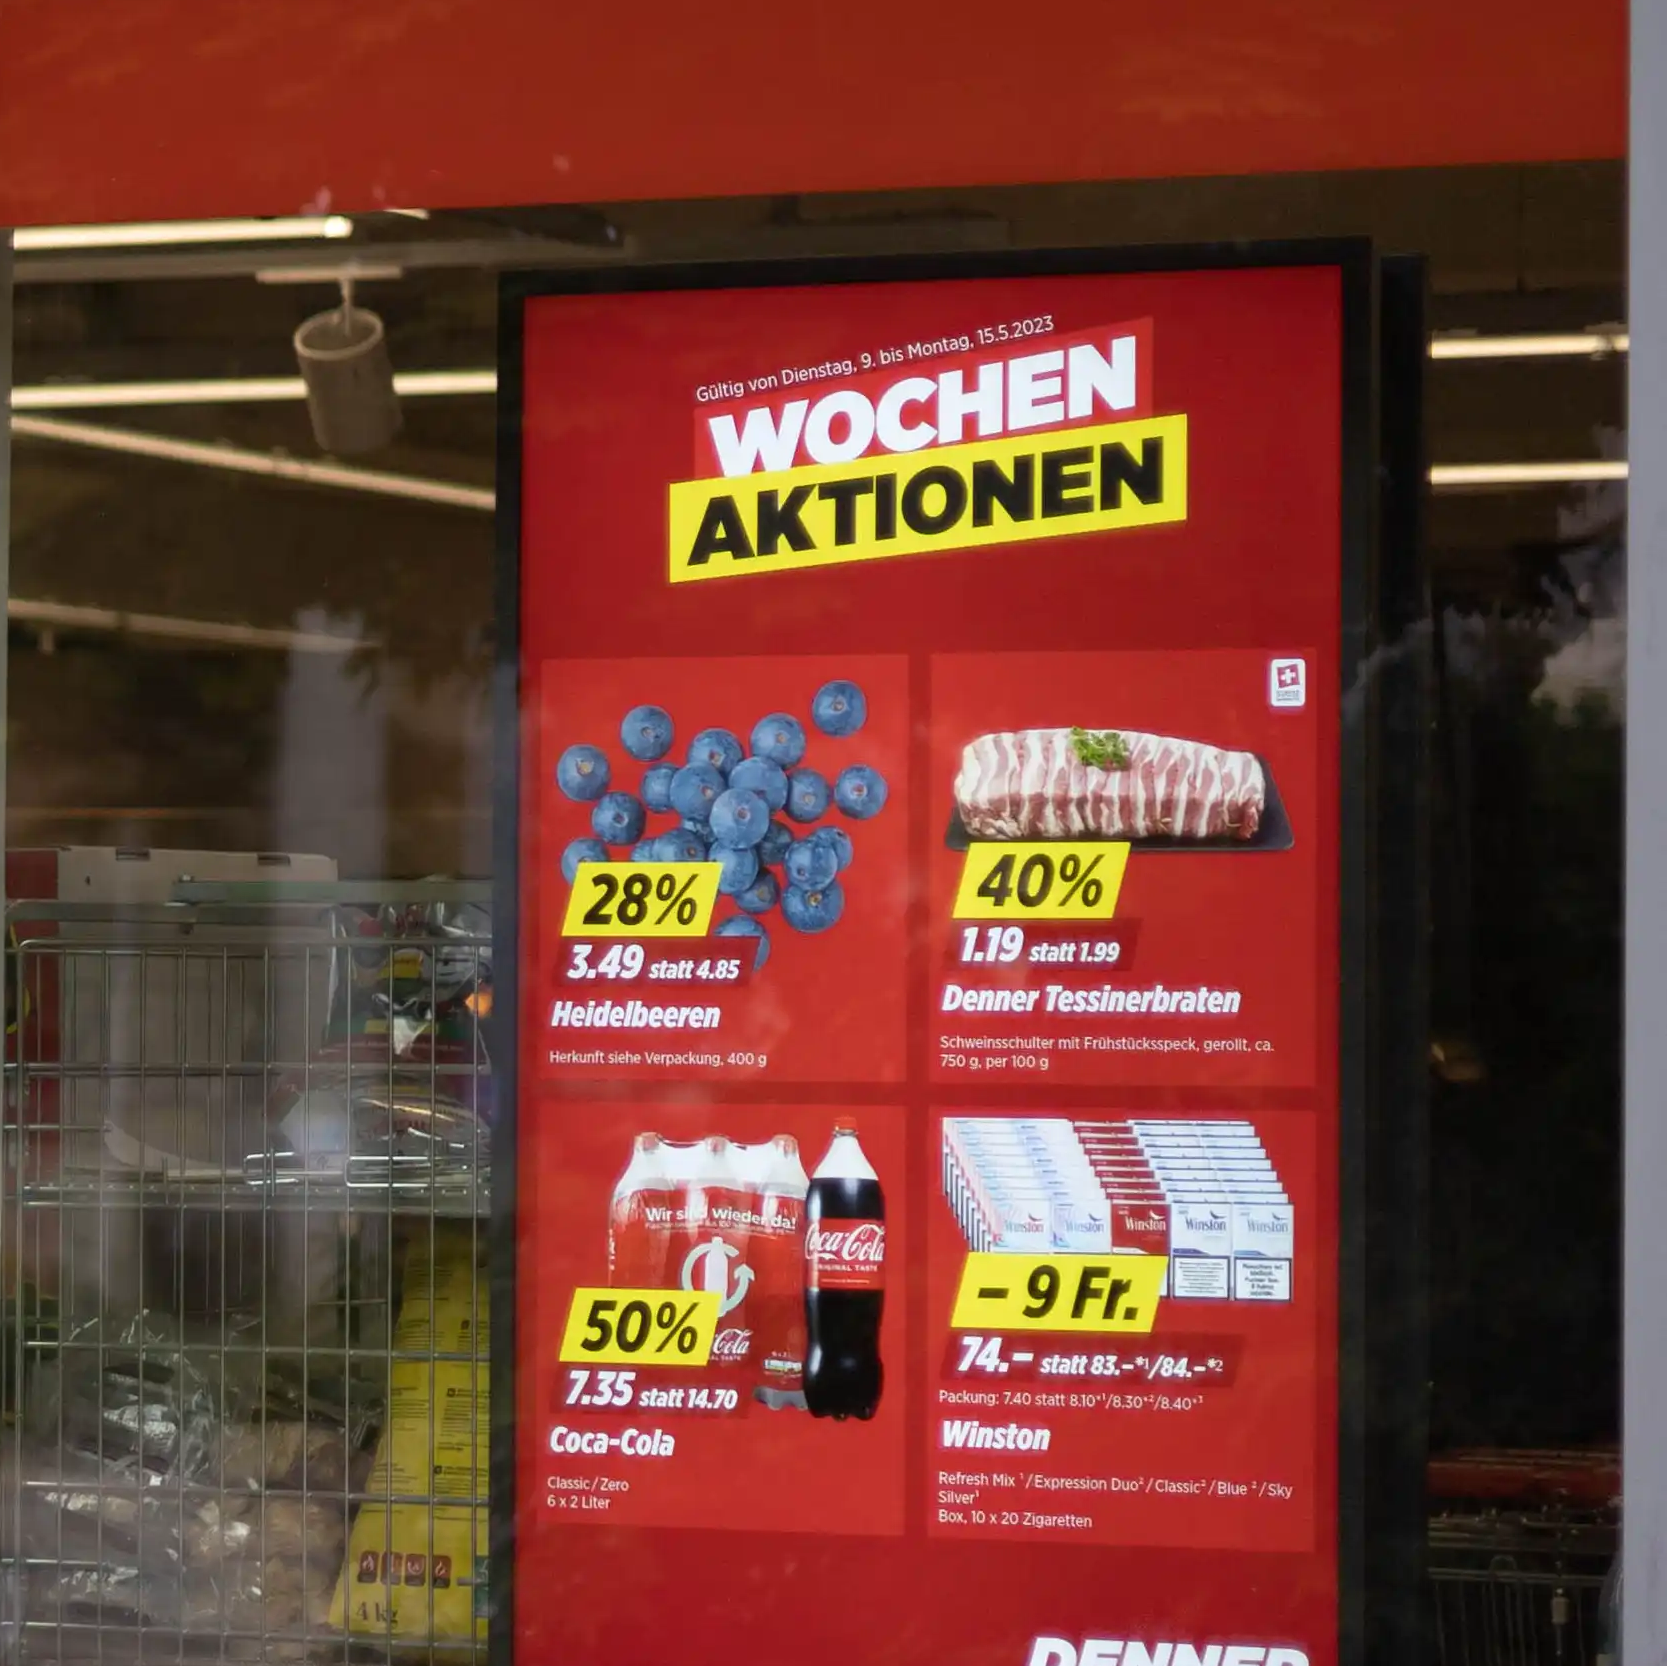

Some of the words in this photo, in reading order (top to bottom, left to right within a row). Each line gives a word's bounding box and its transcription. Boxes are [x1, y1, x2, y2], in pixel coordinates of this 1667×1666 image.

[696, 379, 744, 402] Gültig
[748, 374, 778, 391] von
[782, 357, 858, 385] Dienstag,
[861, 352, 876, 369] 9.
[880, 345, 904, 365] bis
[908, 334, 974, 359] Montag,
[977, 314, 1054, 344] 15.5.2023
[709, 334, 1136, 479] WOCHEN
[686, 435, 1163, 566] AKTIONEN
[977, 853, 1106, 908] 40%
[582, 873, 699, 926] 28%
[961, 926, 1024, 963] 1.19
[1029, 943, 1076, 962] statt
[1080, 942, 1121, 963] 1.99
[567, 944, 645, 980] 3.49
[649, 960, 694, 980] statt
[696, 959, 741, 980] 4.85
[941, 984, 1040, 1012] Denner
[1045, 984, 1242, 1014] Tessinerbraten
[551, 1000, 721, 1028] Heidelbeeren
[940, 1036, 1054, 1051] Schweinsschulter
[1058, 1036, 1081, 1051] mit
[1084, 1036, 1200, 1052] Frühstücksspeck,
[1204, 1037, 1252, 1053] gerollt,
[1255, 1041, 1275, 1052] ca.
[549, 1050, 605, 1065] Herkunft
[608, 1051, 642, 1065] siehe
[645, 1052, 724, 1067] Verpackung,
[727, 1053, 755, 1066] 400
[758, 1054, 767, 1068] g
[940, 1055, 966, 1068] 750
[969, 1057, 982, 1071] g,
[986, 1056, 1008, 1071] per
[1012, 1055, 1035, 1069] 100
[1039, 1057, 1049, 1071] g
[644, 1206, 671, 1222] Wir
[675, 1208, 708, 1221] sid
[770, 1214, 796, 1230] da!
[1005, 1219, 1044, 1233] Winston
[1066, 1219, 1105, 1233] Winston
[1125, 1216, 1167, 1232] Winston
[1185, 1216, 1227, 1232] Winston
[1246, 1216, 1289, 1233] Winston
[805, 1222, 885, 1262] Coca-Cola
[1022, 1263, 1061, 1319] 9
[1071, 1265, 1139, 1321] Fr.
[580, 1300, 701, 1355] 50%
[1040, 1354, 1089, 1375] statt
[565, 1369, 637, 1407] 7.35
[639, 1388, 685, 1408] statt
[687, 1388, 739, 1410] 14.70
[938, 1389, 1000, 1405] Packung:
[1003, 1391, 1032, 1405] 7.40
[1035, 1393, 1067, 1406] statt
[549, 1426, 676, 1457] Coca-Cola
[942, 1420, 1051, 1451] Winston
[938, 1471, 989, 1485] Refresh
[992, 1473, 1016, 1487] Mix
[547, 1494, 556, 1507] 6
[559, 1498, 567, 1508] x
[570, 1496, 579, 1508] 2
[581, 1496, 611, 1509] Liter
[937, 1509, 968, 1524] Box,
[971, 1510, 985, 1524] 10
[989, 1513, 998, 1524] x
[1001, 1511, 1018, 1525] 20
[1022, 1512, 1093, 1529] Zigaretten
